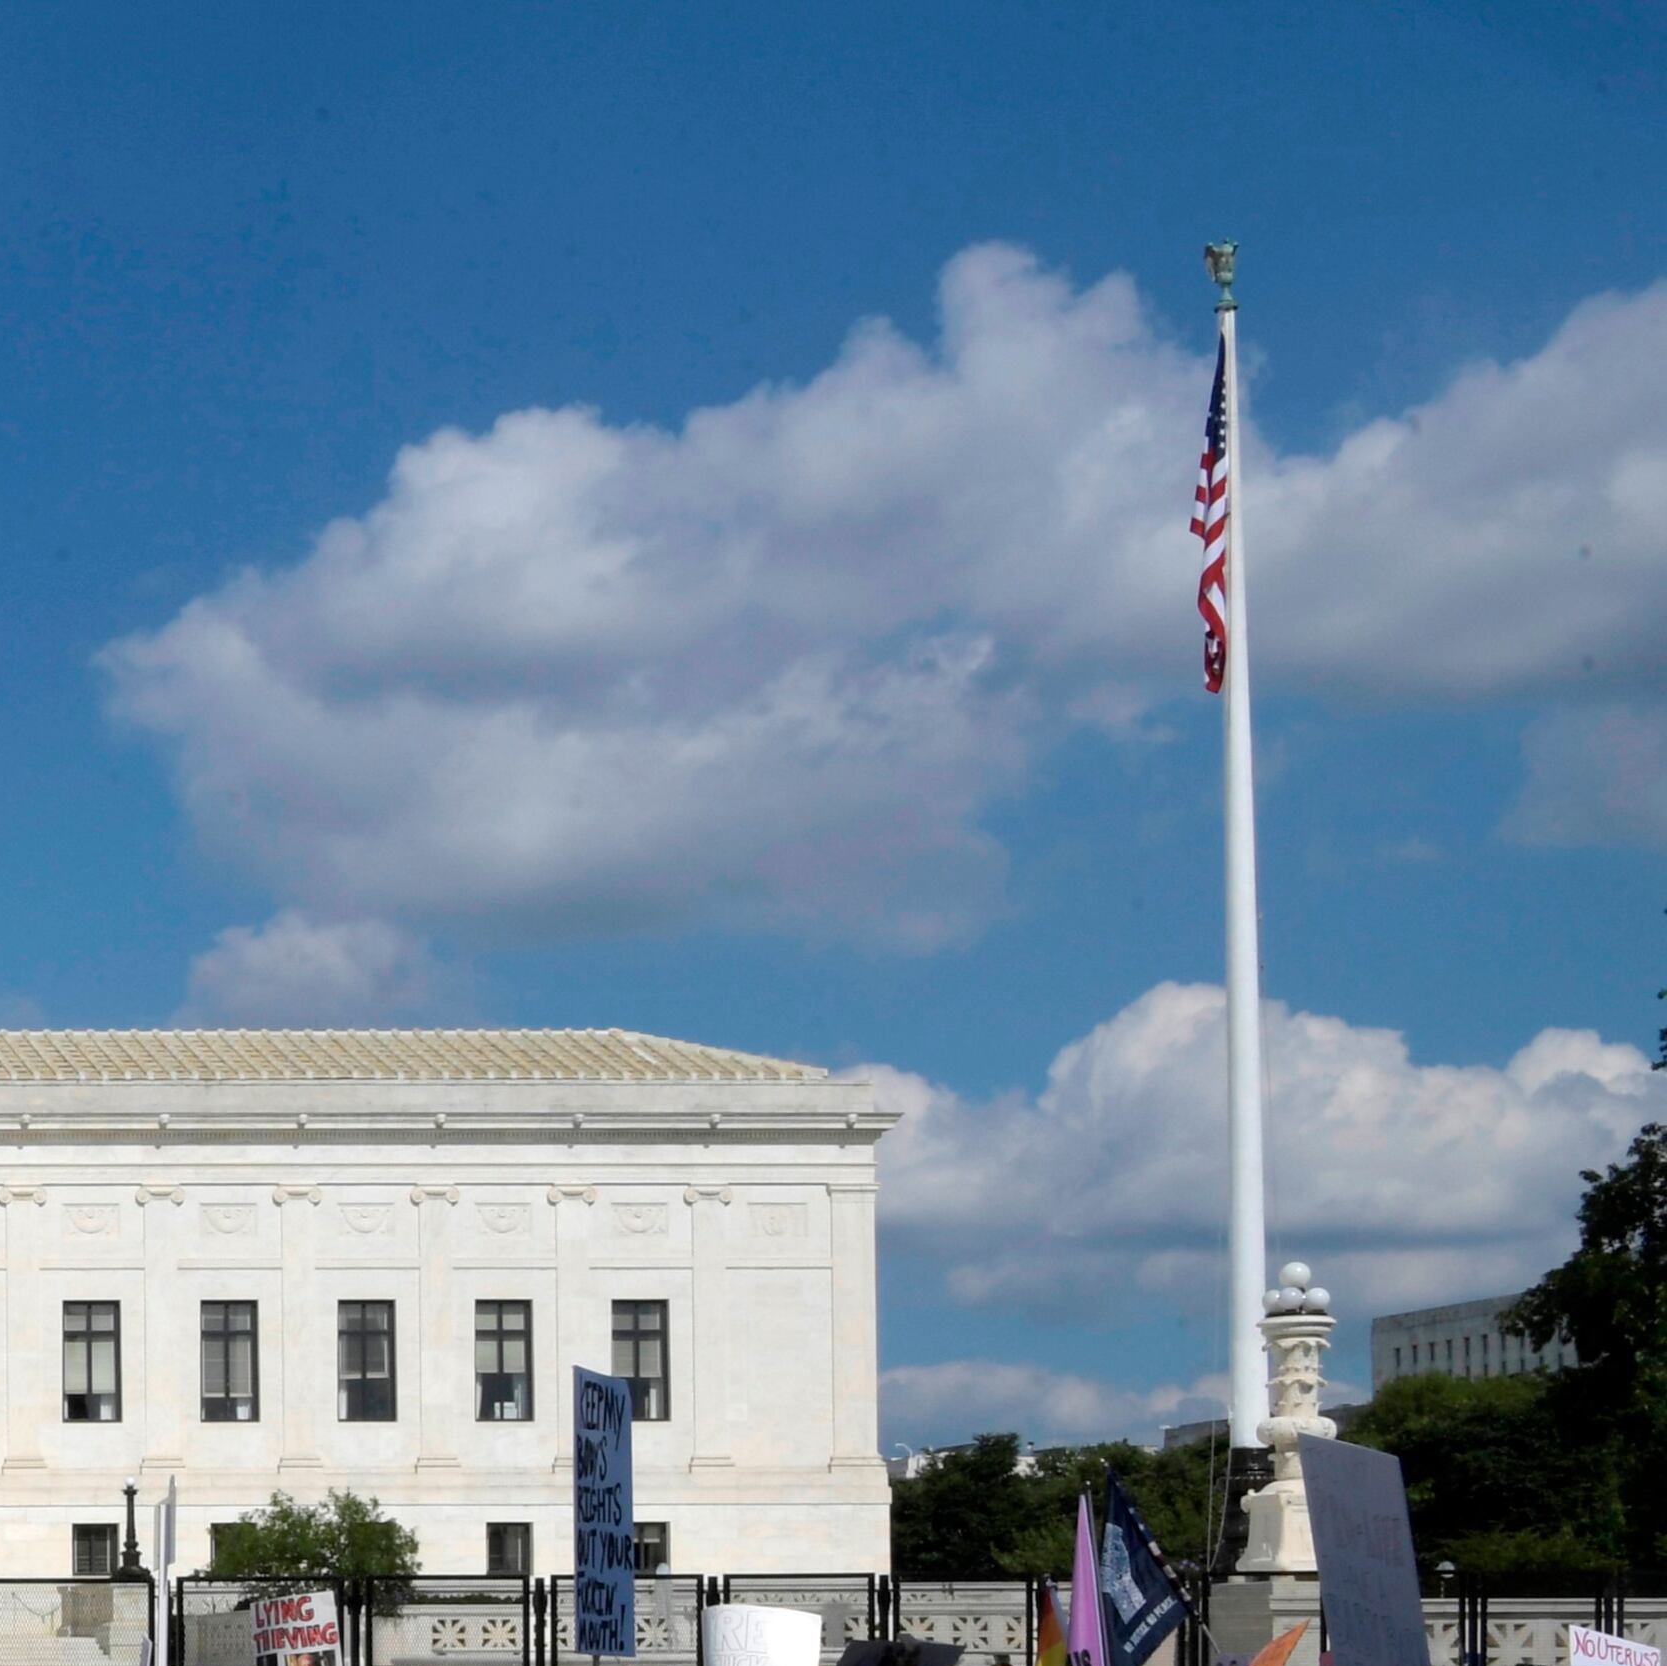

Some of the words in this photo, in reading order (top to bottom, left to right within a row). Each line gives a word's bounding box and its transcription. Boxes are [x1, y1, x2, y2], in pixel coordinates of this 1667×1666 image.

[577, 1483, 622, 1528] RIGHTS
[577, 1529, 596, 1569] OUT
[599, 1531, 633, 1574] YOUR
[255, 1595, 315, 1629] LYING
[1574, 1630, 1596, 1658] NO
